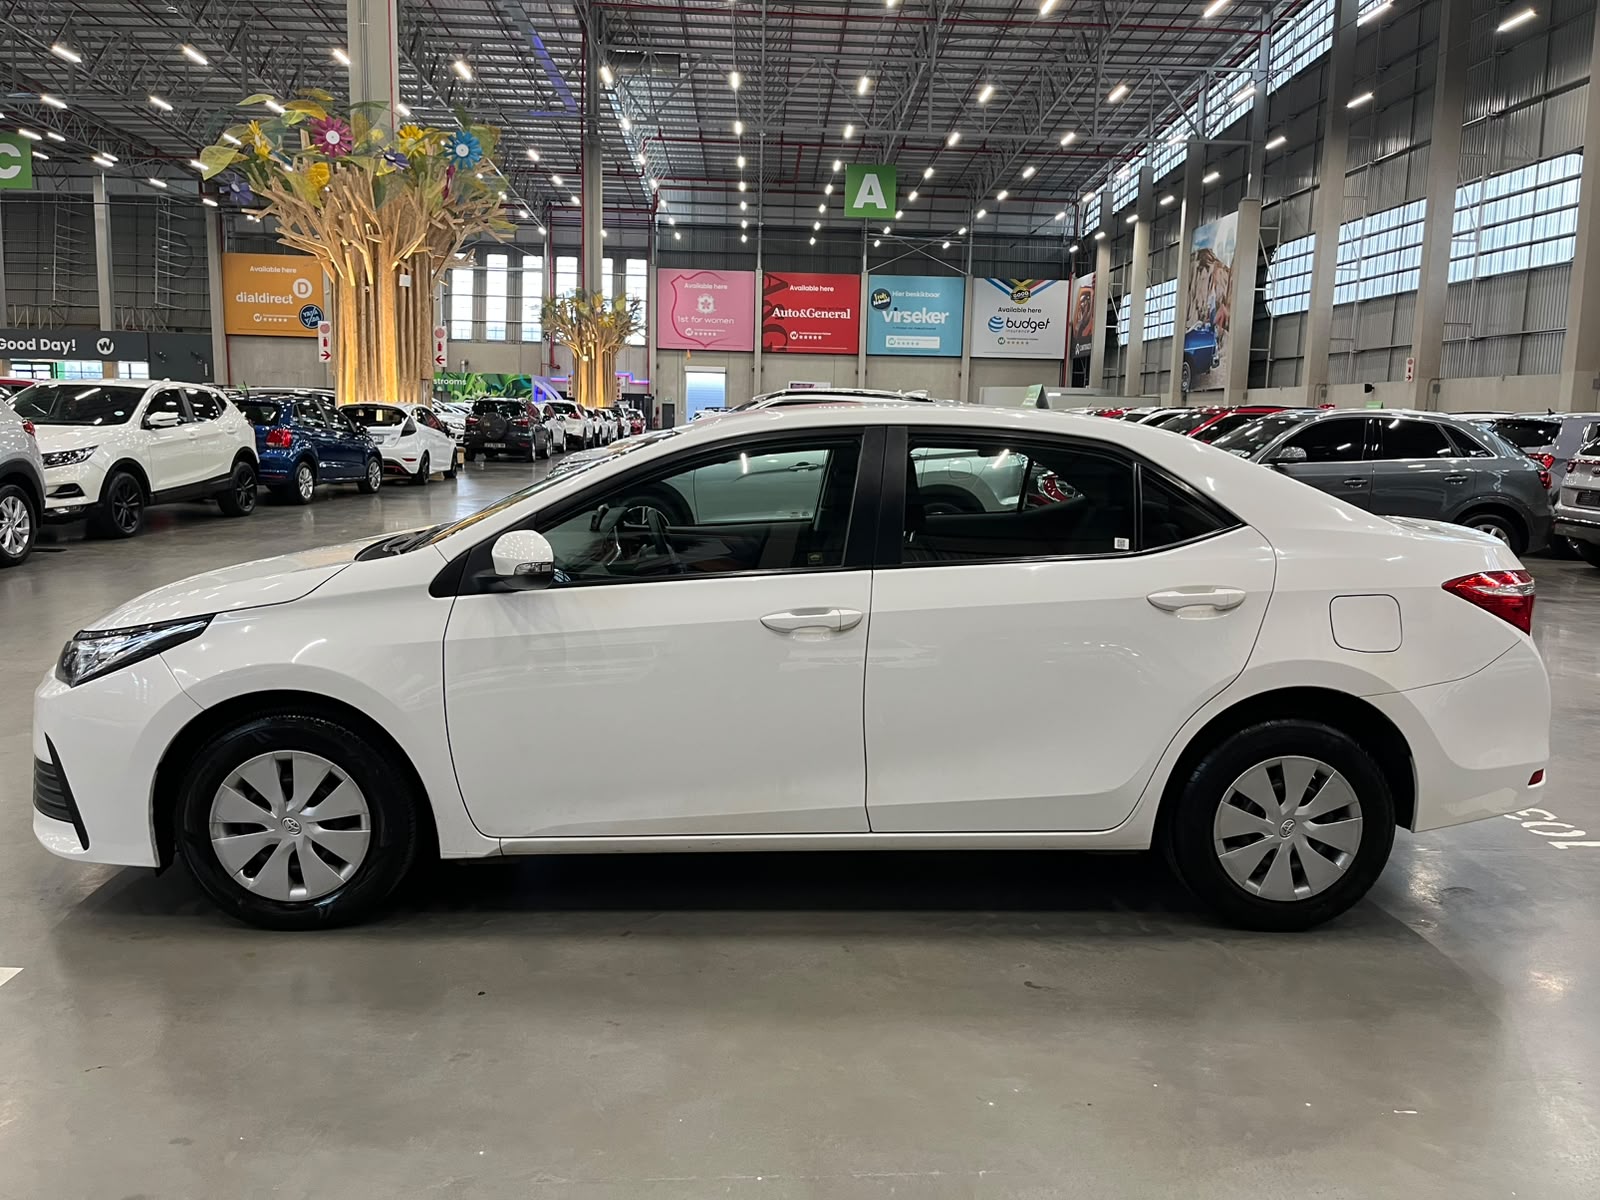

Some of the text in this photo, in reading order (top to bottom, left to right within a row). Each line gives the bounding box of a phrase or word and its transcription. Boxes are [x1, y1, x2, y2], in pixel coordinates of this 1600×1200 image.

[853, 173, 887, 209] A
[281, 266, 297, 274] here
[684, 282, 713, 290] Available
[789, 284, 835, 293] Available here
[236, 292, 293, 304] dialdirect
[772, 307, 851, 320] Auto&General
[881, 307, 949, 324] virseker
[997, 306, 1027, 314] Available
[677, 315, 735, 325] 1st for women
[1006, 317, 1051, 333] budget
[0, 338, 76, 356] Good Day!
[433, 378, 467, 386] strooms
